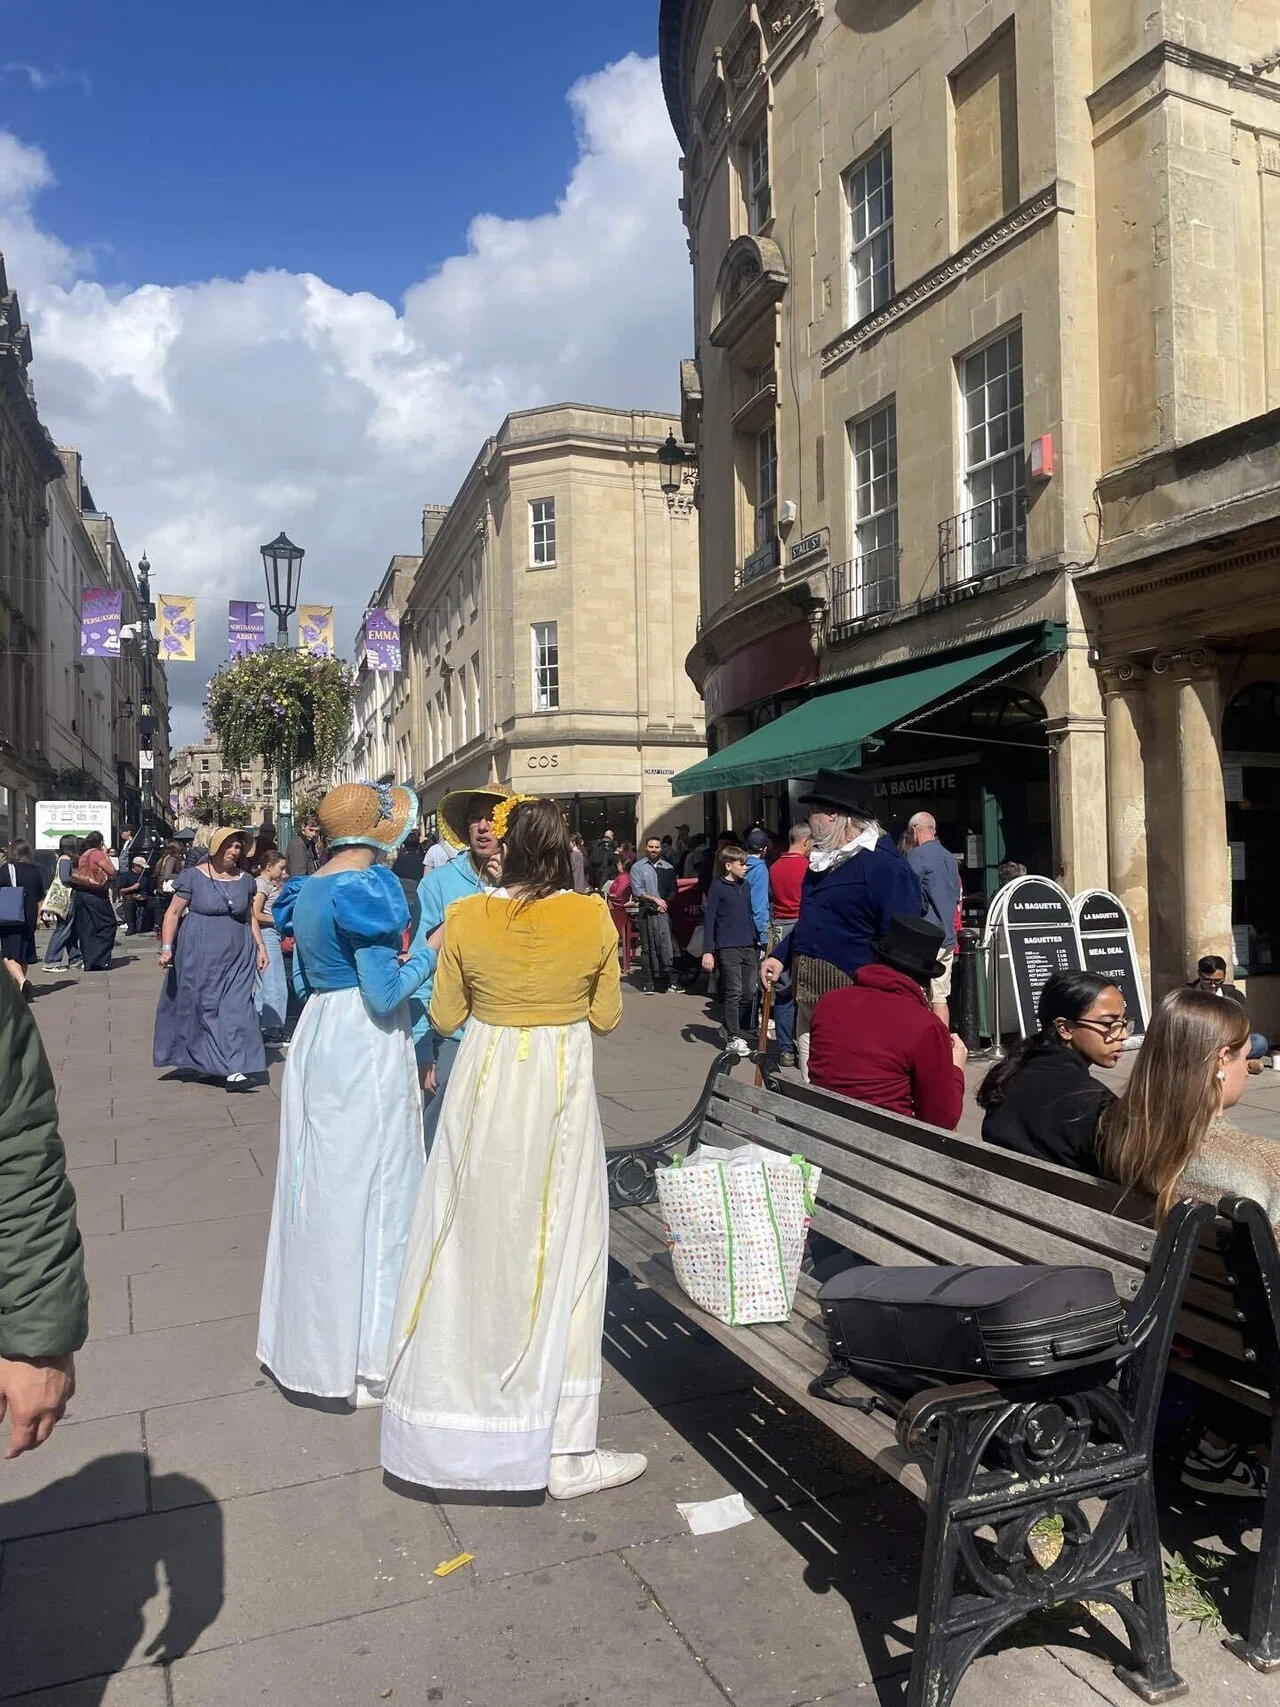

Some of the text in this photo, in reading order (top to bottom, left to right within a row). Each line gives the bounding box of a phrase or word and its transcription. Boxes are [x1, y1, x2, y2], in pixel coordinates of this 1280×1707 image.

[792, 541, 810, 558] STALL
[368, 630, 399, 640] EMMA
[527, 754, 559, 769] COS
[873, 773, 956, 797] LA BAGUETTE
[1024, 936, 1063, 944] BAGUETTES
